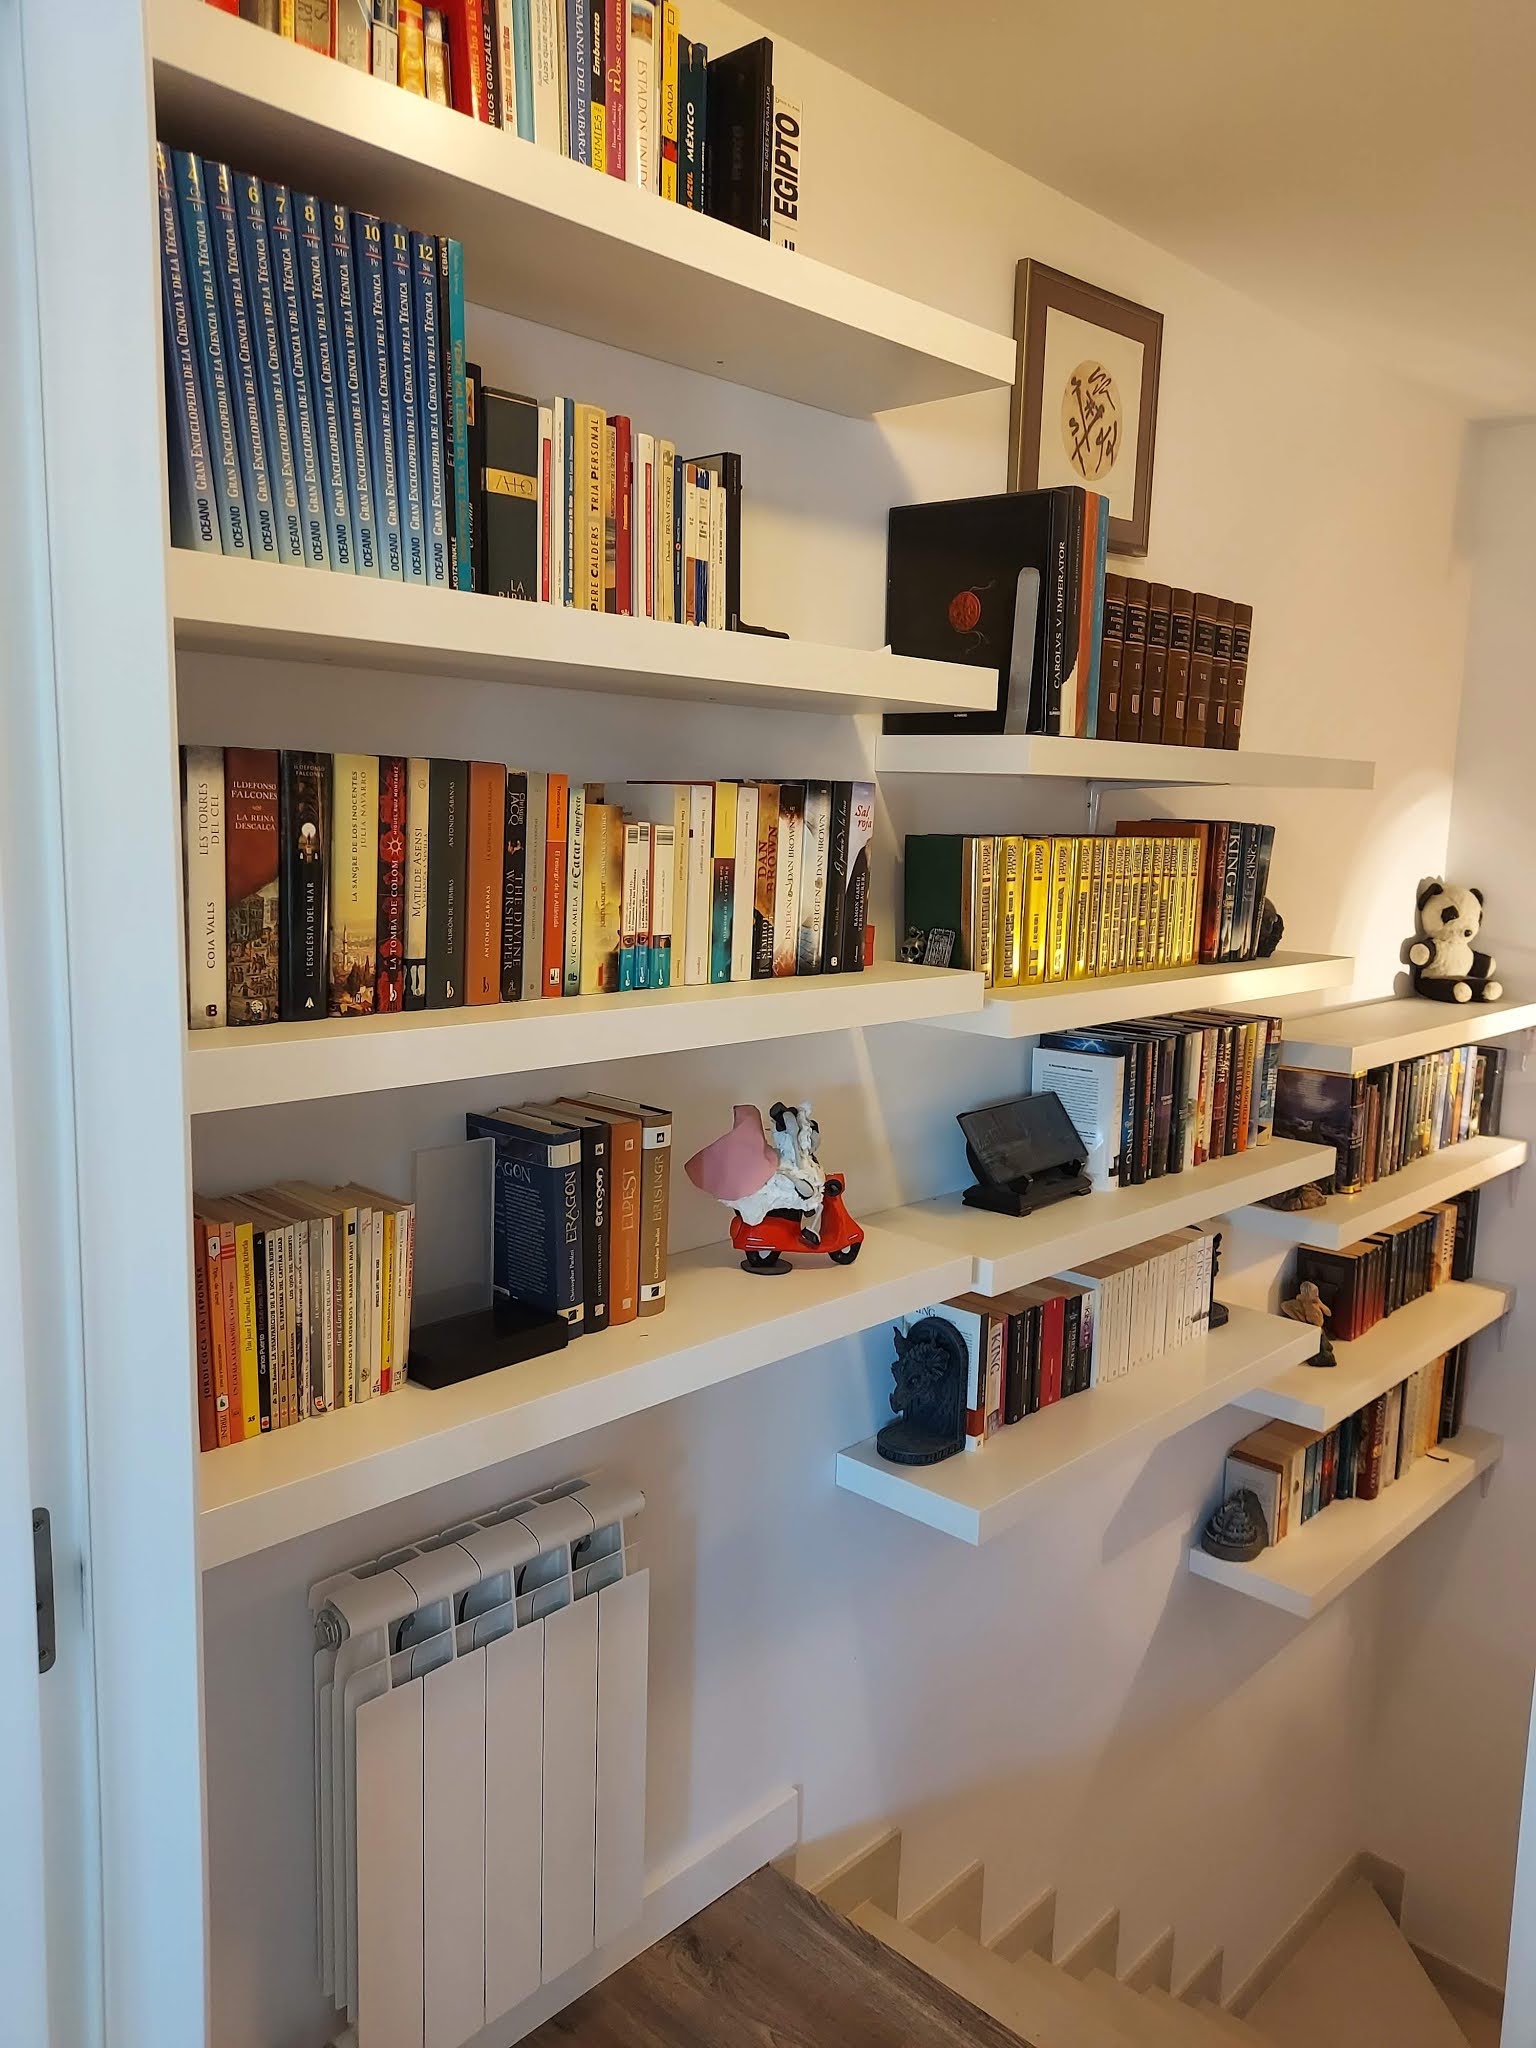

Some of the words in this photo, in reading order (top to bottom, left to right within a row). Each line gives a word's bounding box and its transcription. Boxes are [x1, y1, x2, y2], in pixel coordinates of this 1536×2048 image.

[468, 10, 476, 22] la
[575, 0, 584, 64] SEMANAS
[592, 12, 600, 75] Embarazo
[484, 24, 493, 89] GONZÁLEZ
[576, 66, 584, 94] DEL
[637, 59, 647, 133] ESTADOS
[577, 98, 586, 165] EMBARAZ
[685, 102, 694, 162] MÉXICO
[774, 113, 798, 219] EGIPTO
[248, 186, 259, 203] 6
[276, 196, 285, 213] 7
[304, 205, 315, 222] 8
[334, 215, 344, 231] 9
[364, 224, 380, 242] 10
[394, 234, 407, 251] 11
[418, 244, 433, 262] 12
[340, 264, 351, 307] TÉCNICA
[344, 310, 352, 322] LA
[424, 292, 433, 332] TÉCNICA
[345, 324, 354, 338] DE
[427, 335, 434, 347] LA
[347, 349, 358, 389] CIENCIA
[427, 348, 435, 362] DE
[351, 392, 360, 404] LA
[427, 372, 437, 410] CIENCIA
[352, 406, 361, 419] DE
[430, 413, 438, 424] LA
[430, 426, 438, 439] DE
[354, 422, 367, 491] ENCICLOPEDIA
[590, 420, 598, 480] PERSONAL
[432, 442, 441, 507] ENCICLOPEDIA
[359, 494, 370, 521] GRAN
[590, 485, 598, 511] TRIA
[433, 510, 442, 535] GRAN
[361, 528, 373, 567] OCEANO
[434, 542, 443, 580] OCEANO
[590, 527, 598, 578] CALDERS
[511, 579, 524, 592] LA
[590, 582, 598, 612] PERE
[1056, 618, 1061, 626] V
[231, 790, 277, 800] FALCONES
[233, 781, 276, 790] ILDEFONSO
[198, 783, 208, 830] TORRES
[210, 797, 219, 817] CEL
[251, 814, 274, 822] REINA
[508, 791, 519, 825] JACQ
[517, 792, 525, 824] Christian
[574, 796, 583, 836] imperfecte
[854, 804, 870, 817] Sal
[211, 824, 219, 844] DEL
[857, 818, 872, 831] roja
[199, 836, 208, 854] LES
[352, 842, 357, 852] DE
[413, 827, 422, 865] ASENSI
[555, 849, 560, 857] El
[757, 840, 768, 879] DAN
[766, 826, 778, 893] BROWN
[834, 861, 845, 876] El
[1226, 835, 1240, 887] KING
[306, 882, 314, 902] MAR
[351, 892, 357, 901] LA
[412, 868, 421, 917] MATILDE
[512, 873, 523, 905] THE
[206, 902, 214, 935] VALLS
[306, 906, 314, 922] DEL
[390, 900, 397, 914] DE
[504, 870, 514, 969] WORSHIPPER
[512, 912, 523, 966] DIVINE
[206, 939, 215, 968] COIA
[389, 957, 396, 969] LA
[595, 1167, 605, 1226] eragon
[622, 1169, 636, 1230] ELDEST
[653, 1154, 663, 1220] BRISINGR
[565, 1171, 579, 1243] ERAGON
[1195, 1248, 1203, 1288] KING
[196, 1267, 205, 1315] JAPONESA
[199, 1319, 206, 1330] LA
[279, 1323, 284, 1331] EL
[990, 1332, 1001, 1375] KING
[203, 1368, 211, 1398] JORDI
